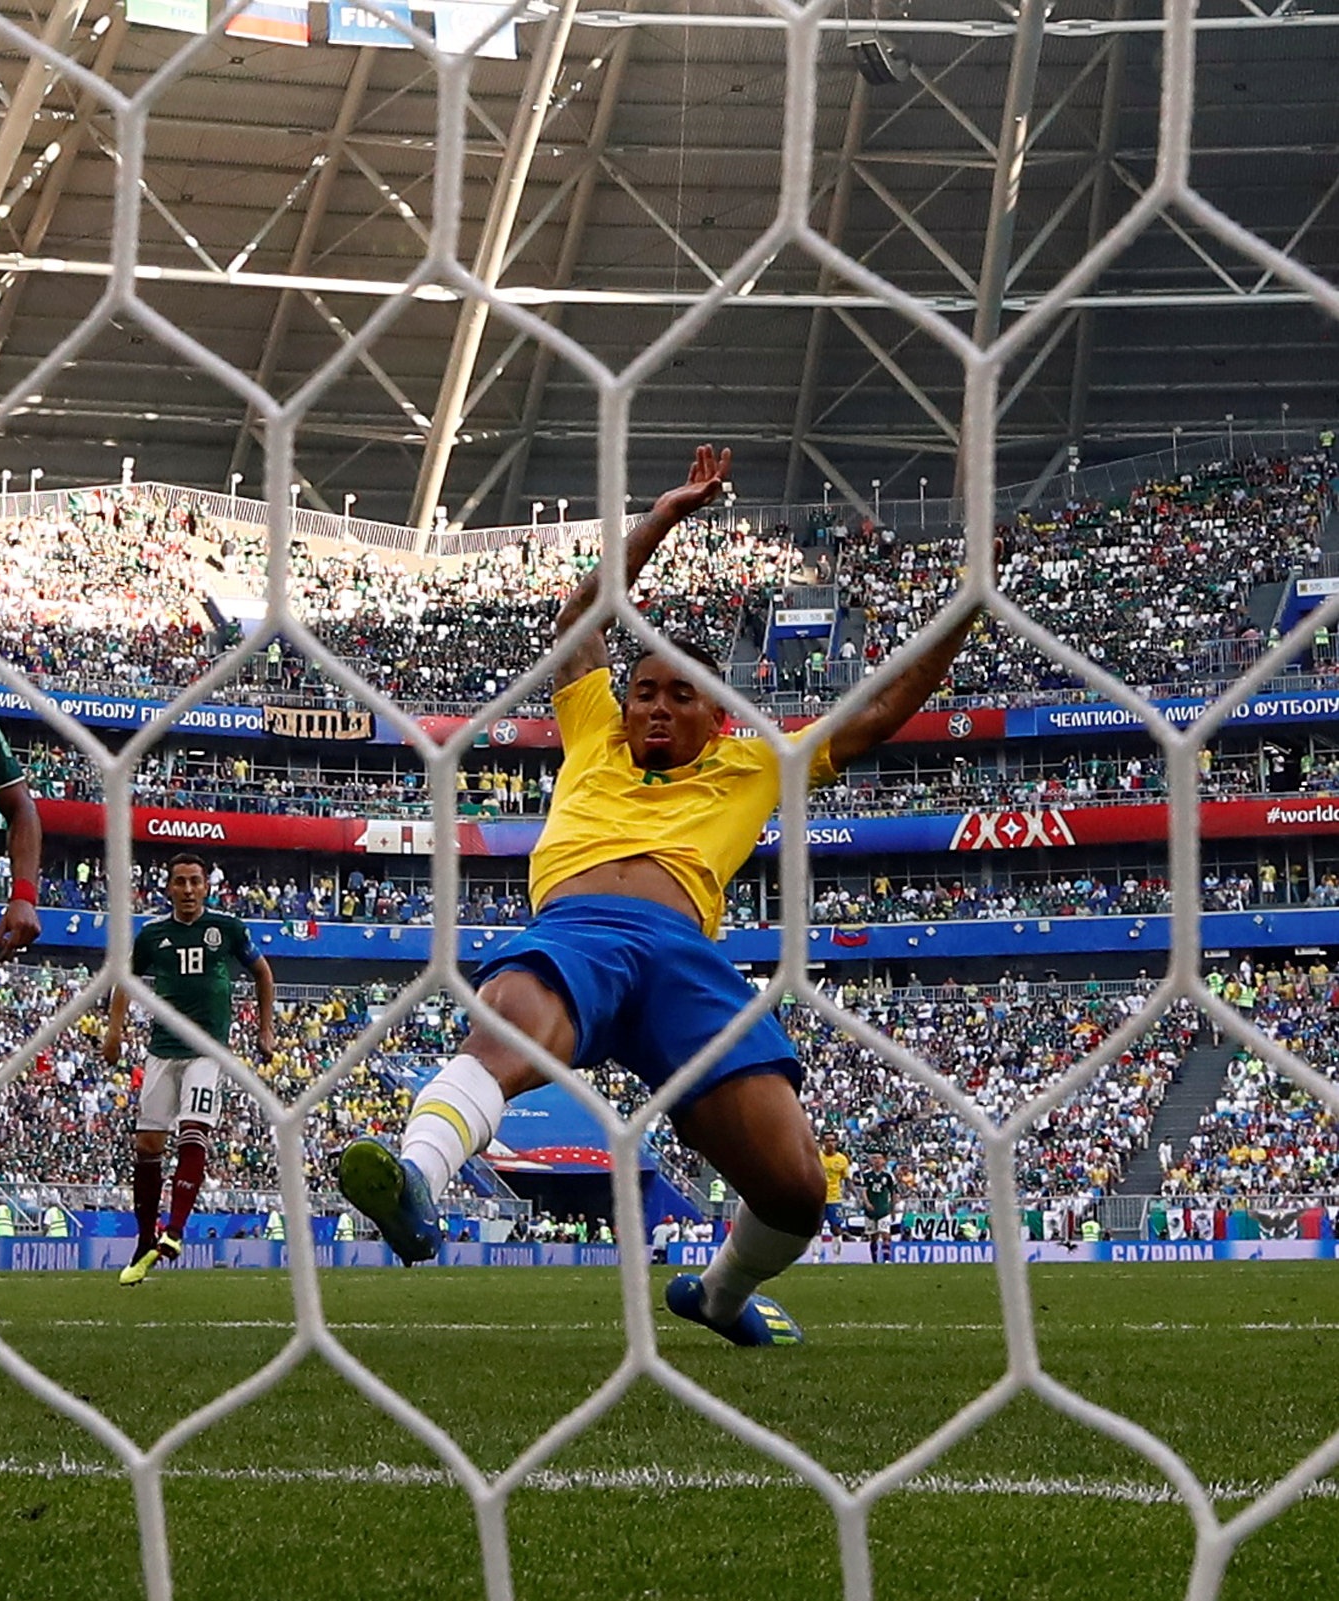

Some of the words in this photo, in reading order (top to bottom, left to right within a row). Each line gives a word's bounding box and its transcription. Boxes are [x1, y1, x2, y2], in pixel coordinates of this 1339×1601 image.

[62, 699, 136, 719] ФУТБОЛУ
[179, 710, 217, 728] 2018
[1254, 698, 1339, 717] ФУТБОЛУ
[148, 819, 225, 839] САМАРА
[176, 946, 204, 975] 18
[191, 1087, 213, 1114] 18
[12, 1242, 79, 1270] GAZPROM
[894, 1245, 994, 1263] GAZPROM
[1111, 1244, 1214, 1261] GAZPROM
